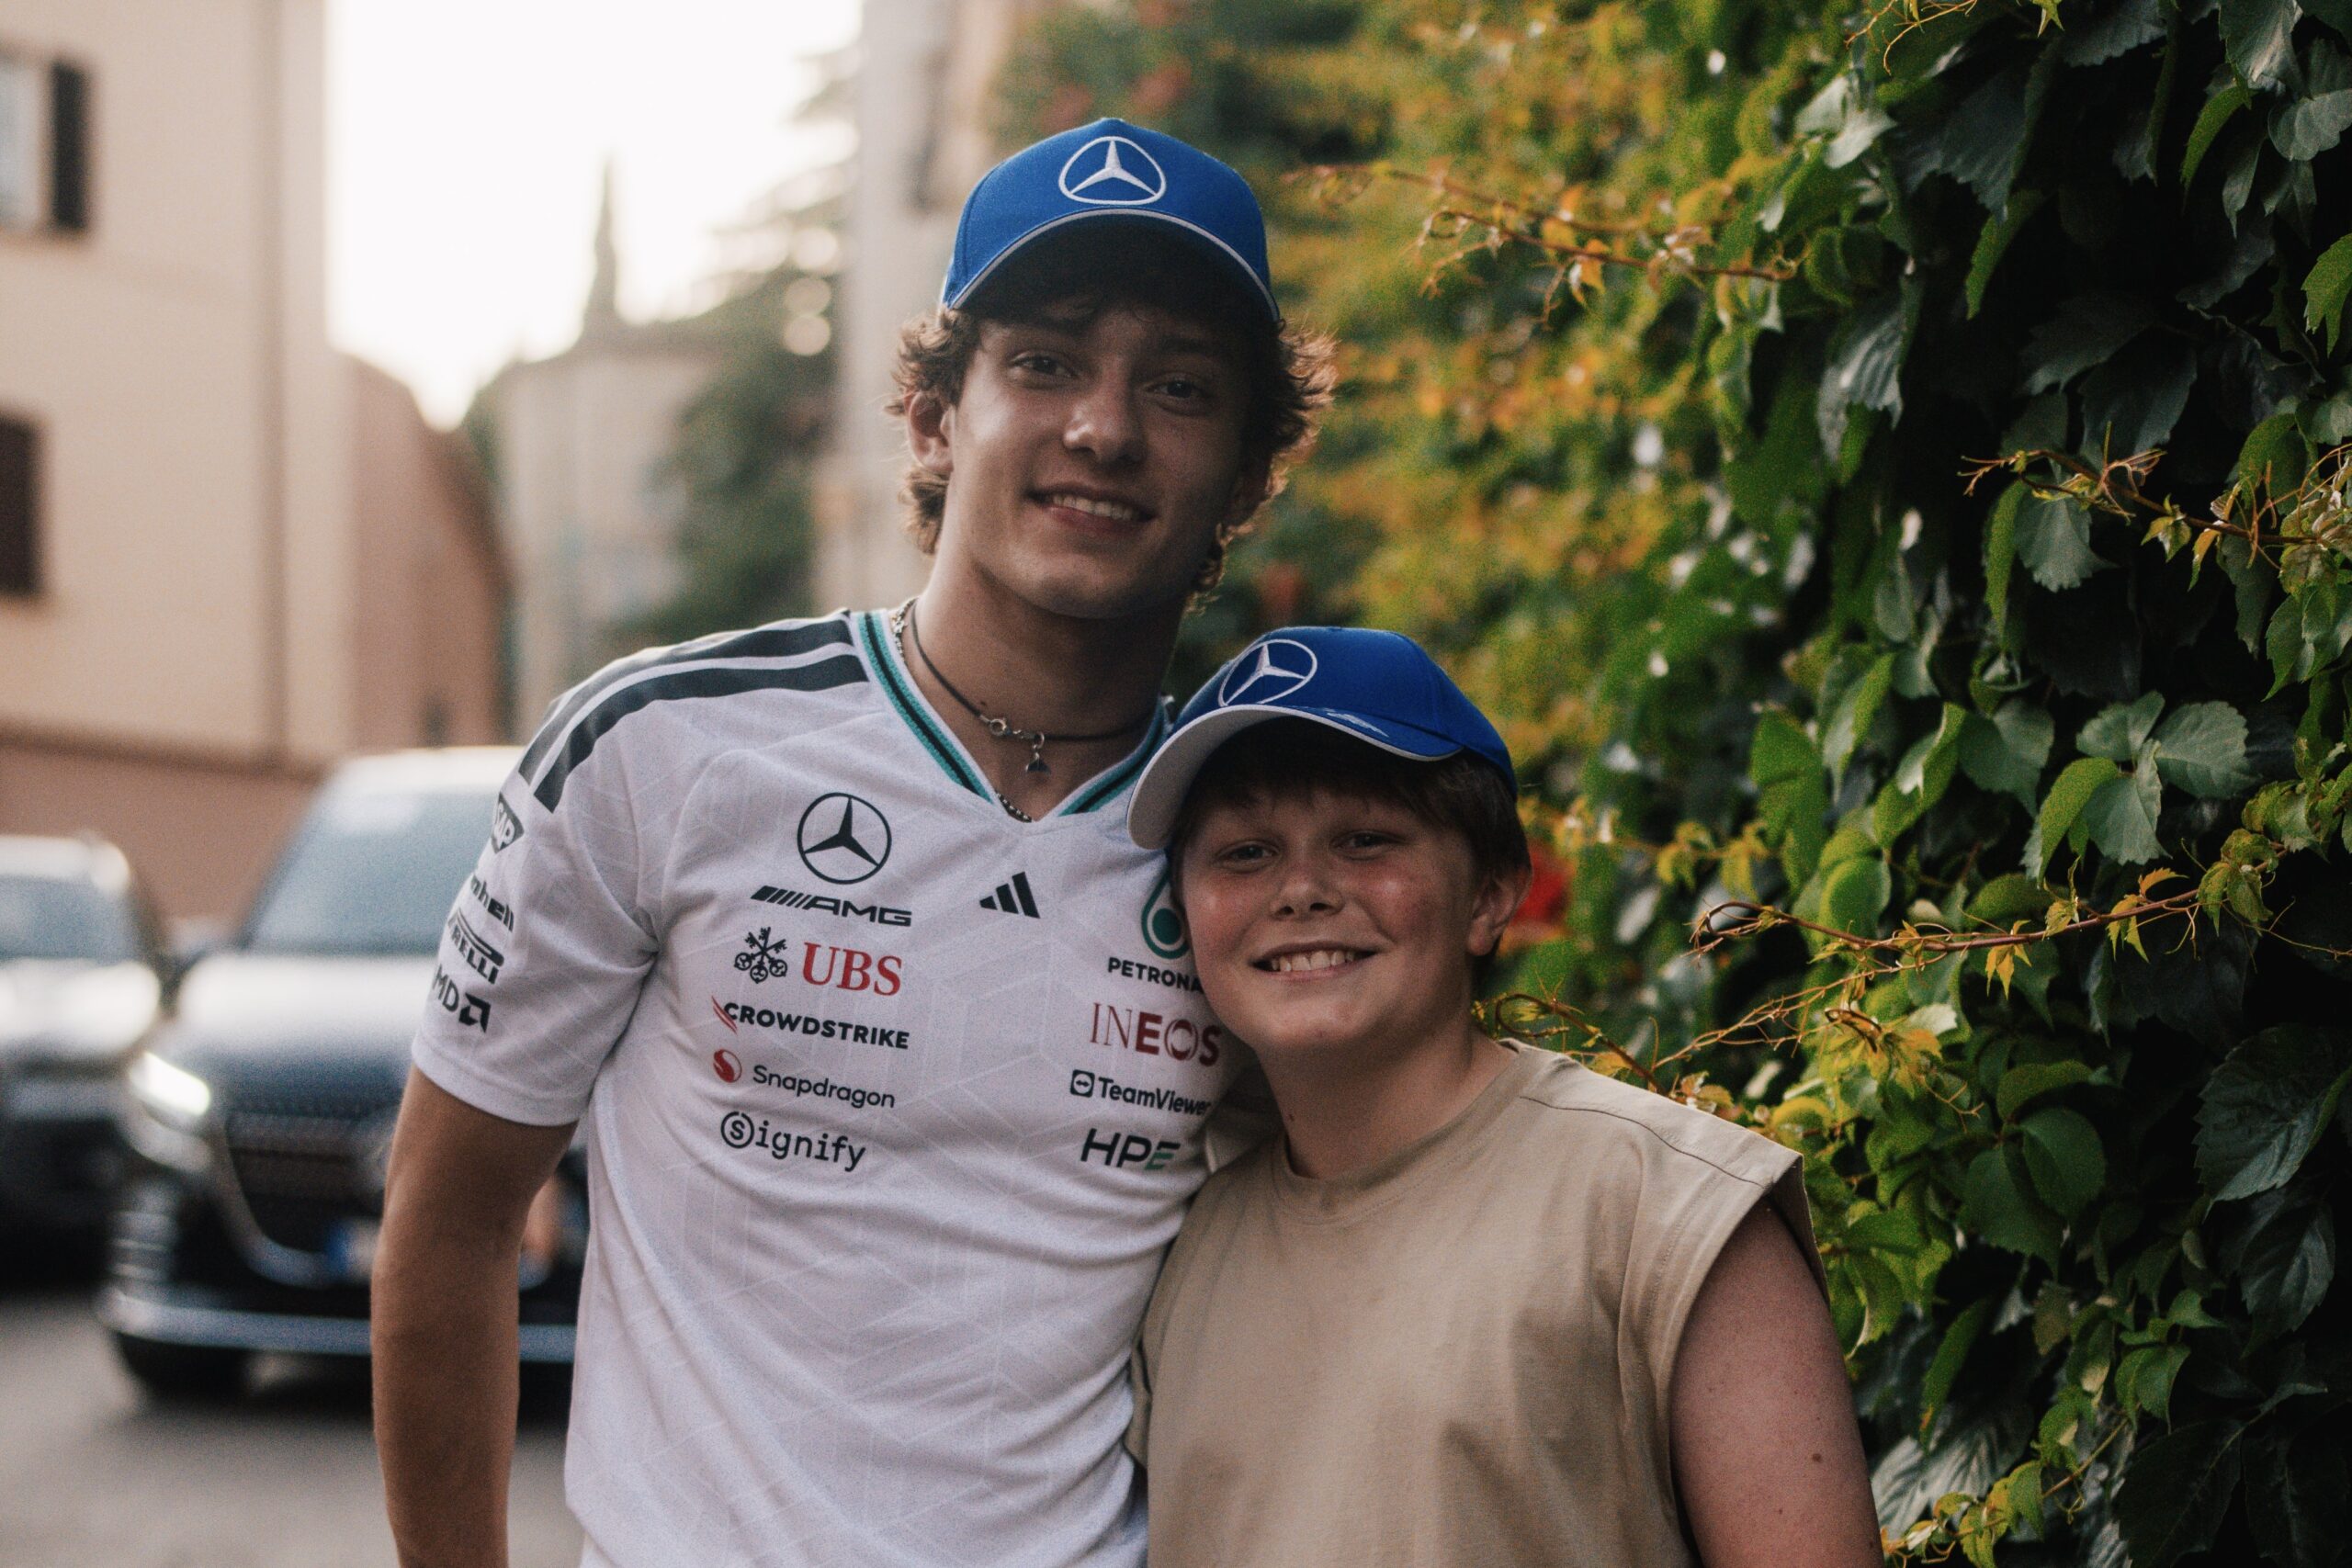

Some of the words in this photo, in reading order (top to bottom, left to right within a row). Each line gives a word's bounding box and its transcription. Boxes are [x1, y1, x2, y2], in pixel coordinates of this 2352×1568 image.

[802, 896, 912, 927] AMG
[431, 964, 459, 1012] MD
[802, 942, 902, 996] UBS
[1107, 956, 1204, 994] PETRONA
[724, 1002, 910, 1050] CROWDSTRIKE
[1090, 1002, 1222, 1066] INEOS
[752, 1064, 895, 1109] Snapdragon
[1098, 1076, 1211, 1116] TeamViewer
[1080, 1127, 1182, 1171] HPE
